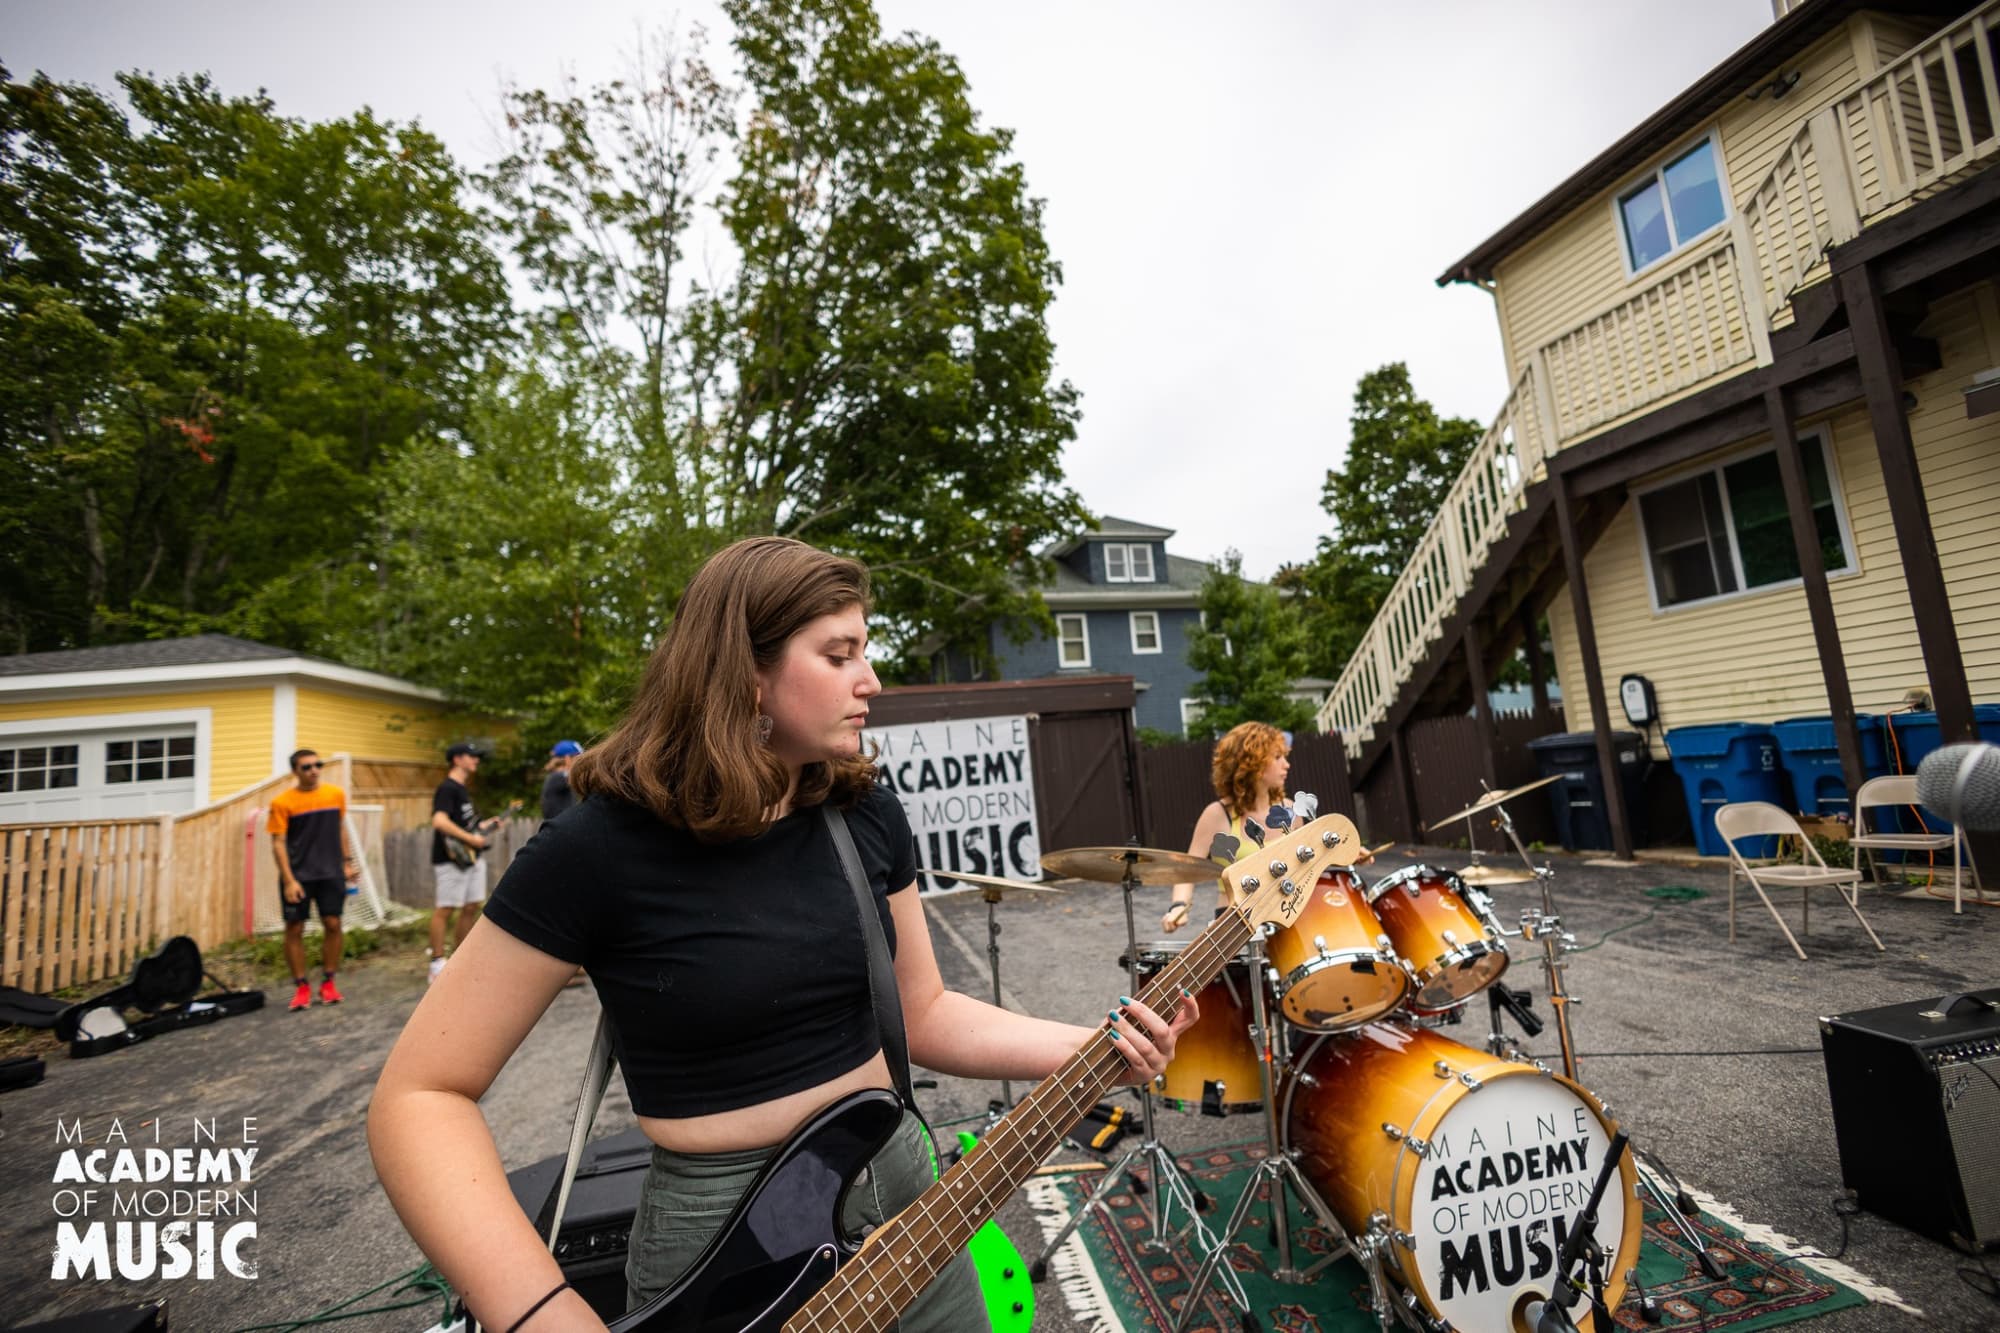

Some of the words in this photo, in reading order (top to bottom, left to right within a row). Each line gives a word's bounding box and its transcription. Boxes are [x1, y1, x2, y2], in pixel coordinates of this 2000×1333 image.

[872, 719, 1025, 757] MAINE
[877, 749, 1026, 795] ACADEMY
[922, 790, 1031, 827] MODERN
[1428, 1107, 1588, 1161] MAINE
[1431, 1137, 1590, 1201] ACADEMY
[1432, 1203, 1471, 1235] OF
[1483, 1177, 1595, 1226] MODERN
[1439, 1215, 1569, 1301] MUSI
